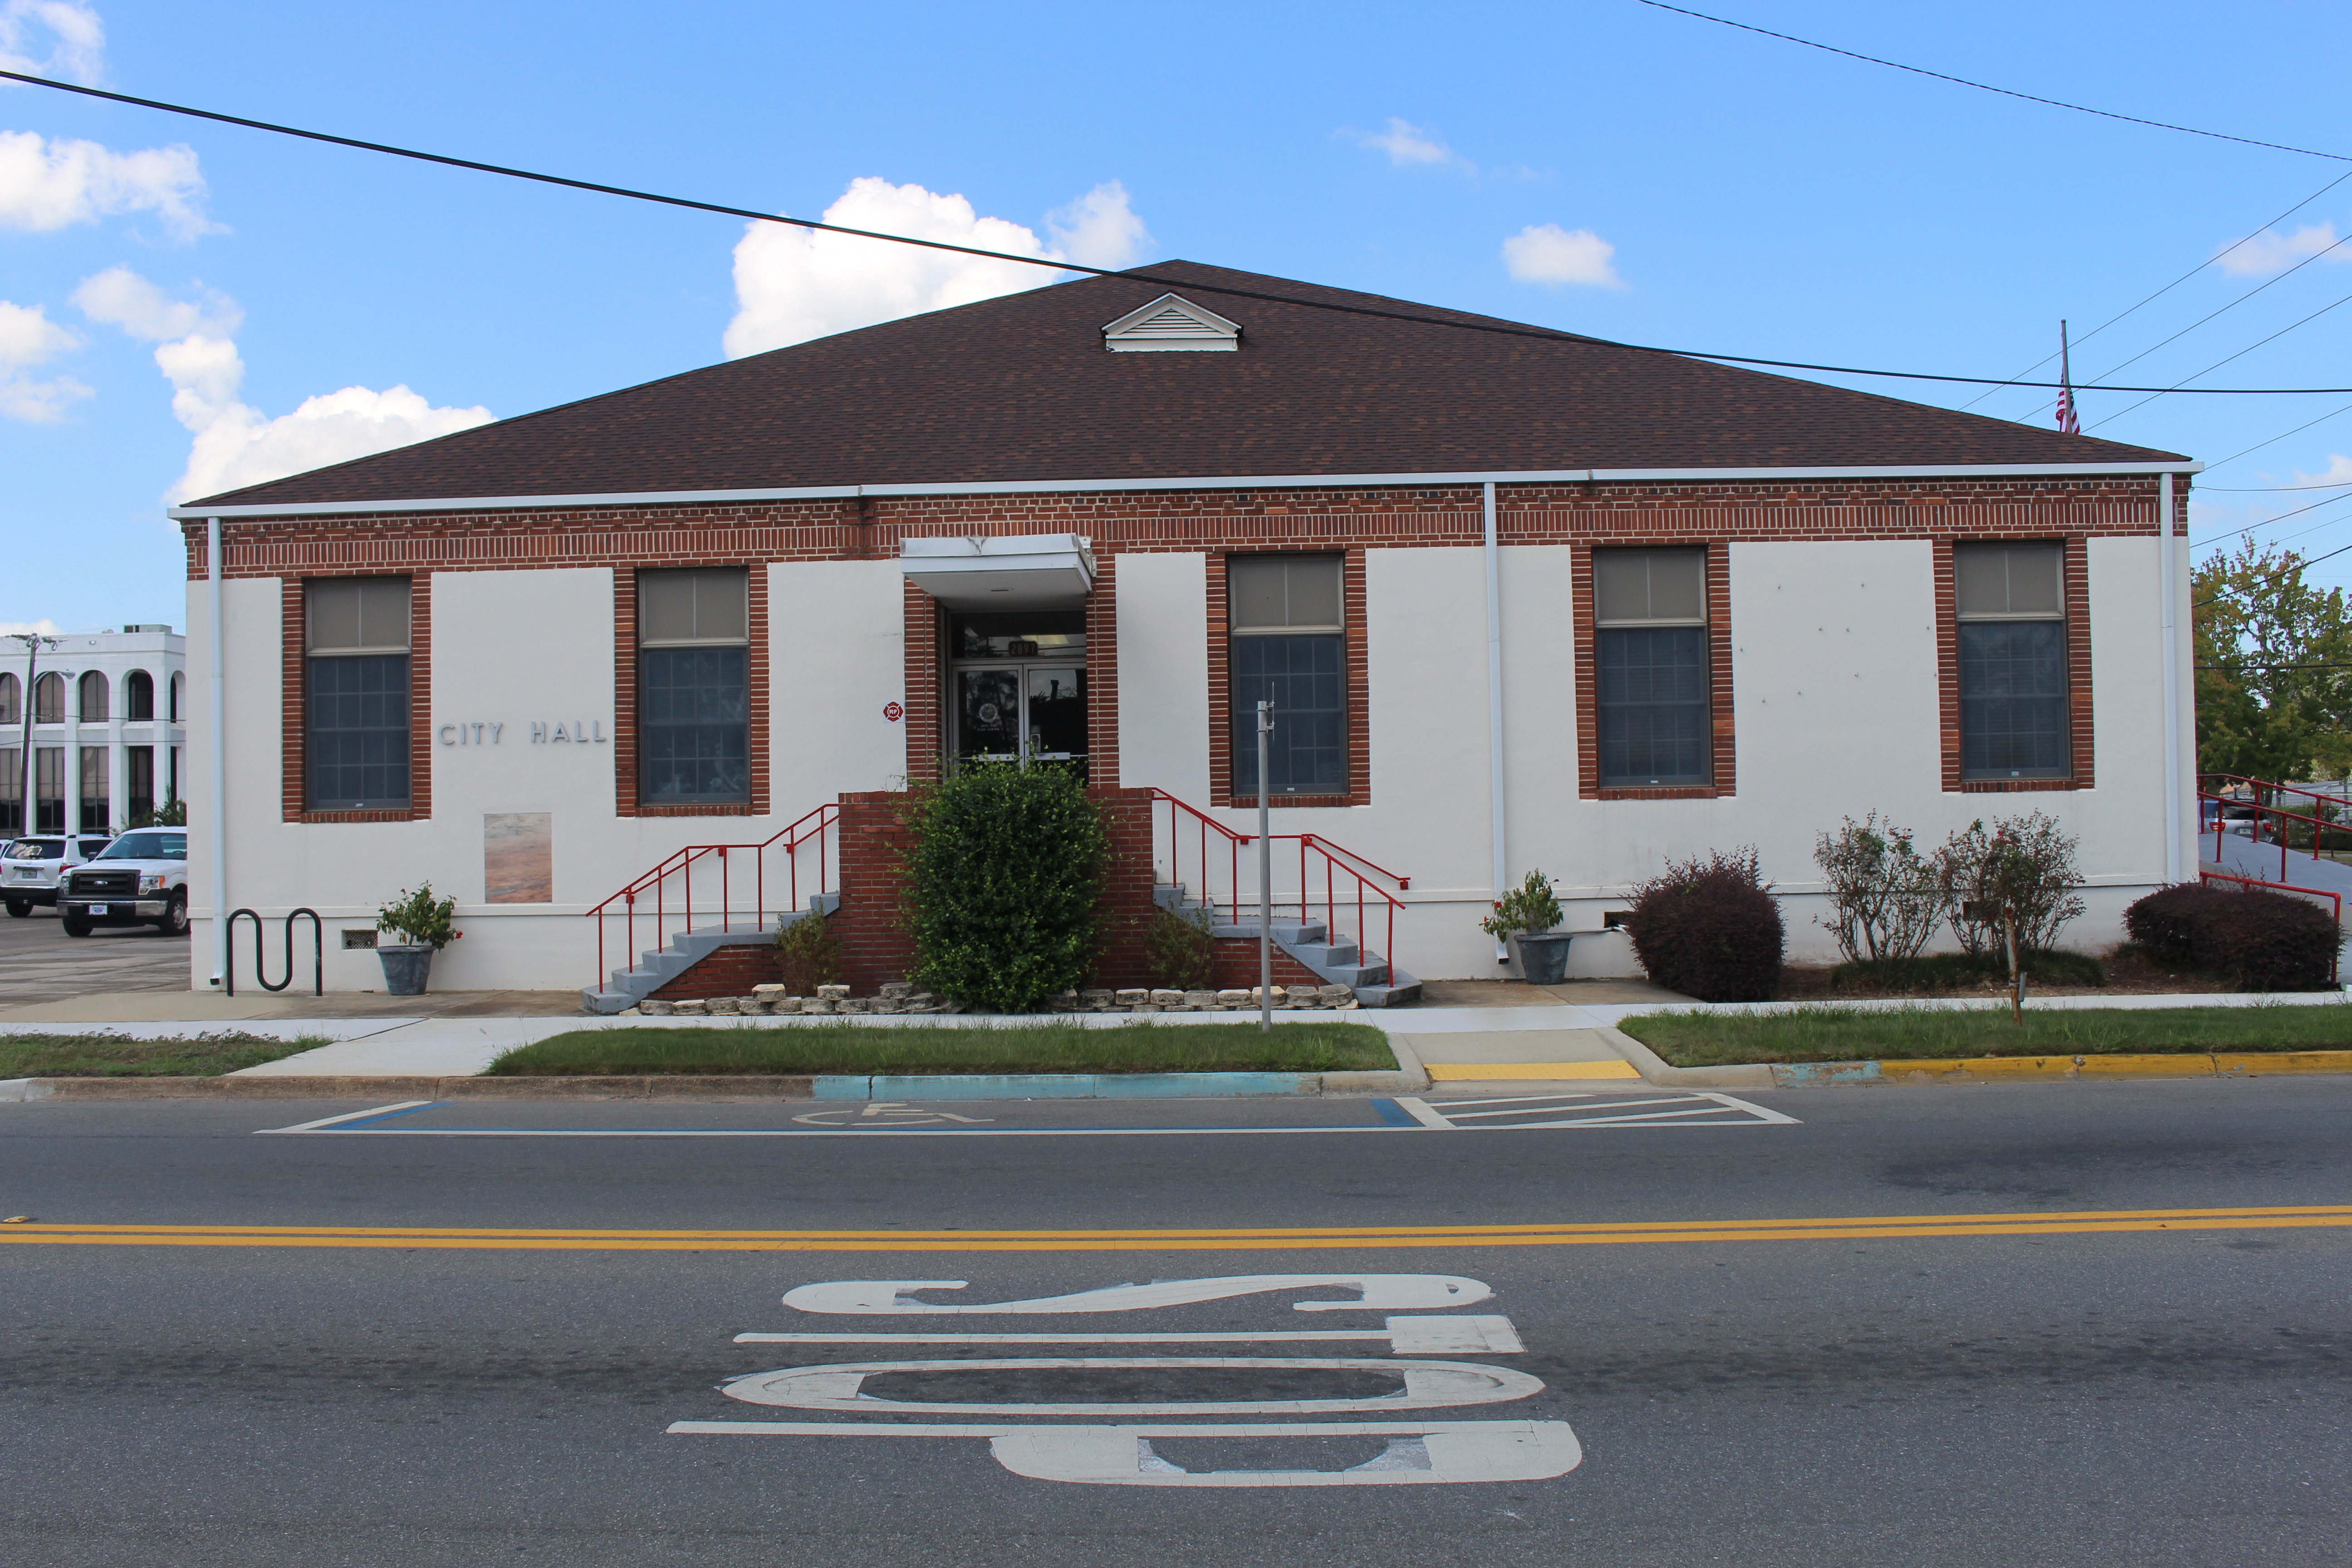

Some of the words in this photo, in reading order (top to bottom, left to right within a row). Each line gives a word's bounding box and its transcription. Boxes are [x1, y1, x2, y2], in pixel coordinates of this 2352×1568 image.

[1011, 643, 1035, 654] 2897
[437, 722, 503, 745] CITY
[530, 720, 606, 743] HALL
[666, 1274, 1583, 1487] STOP
